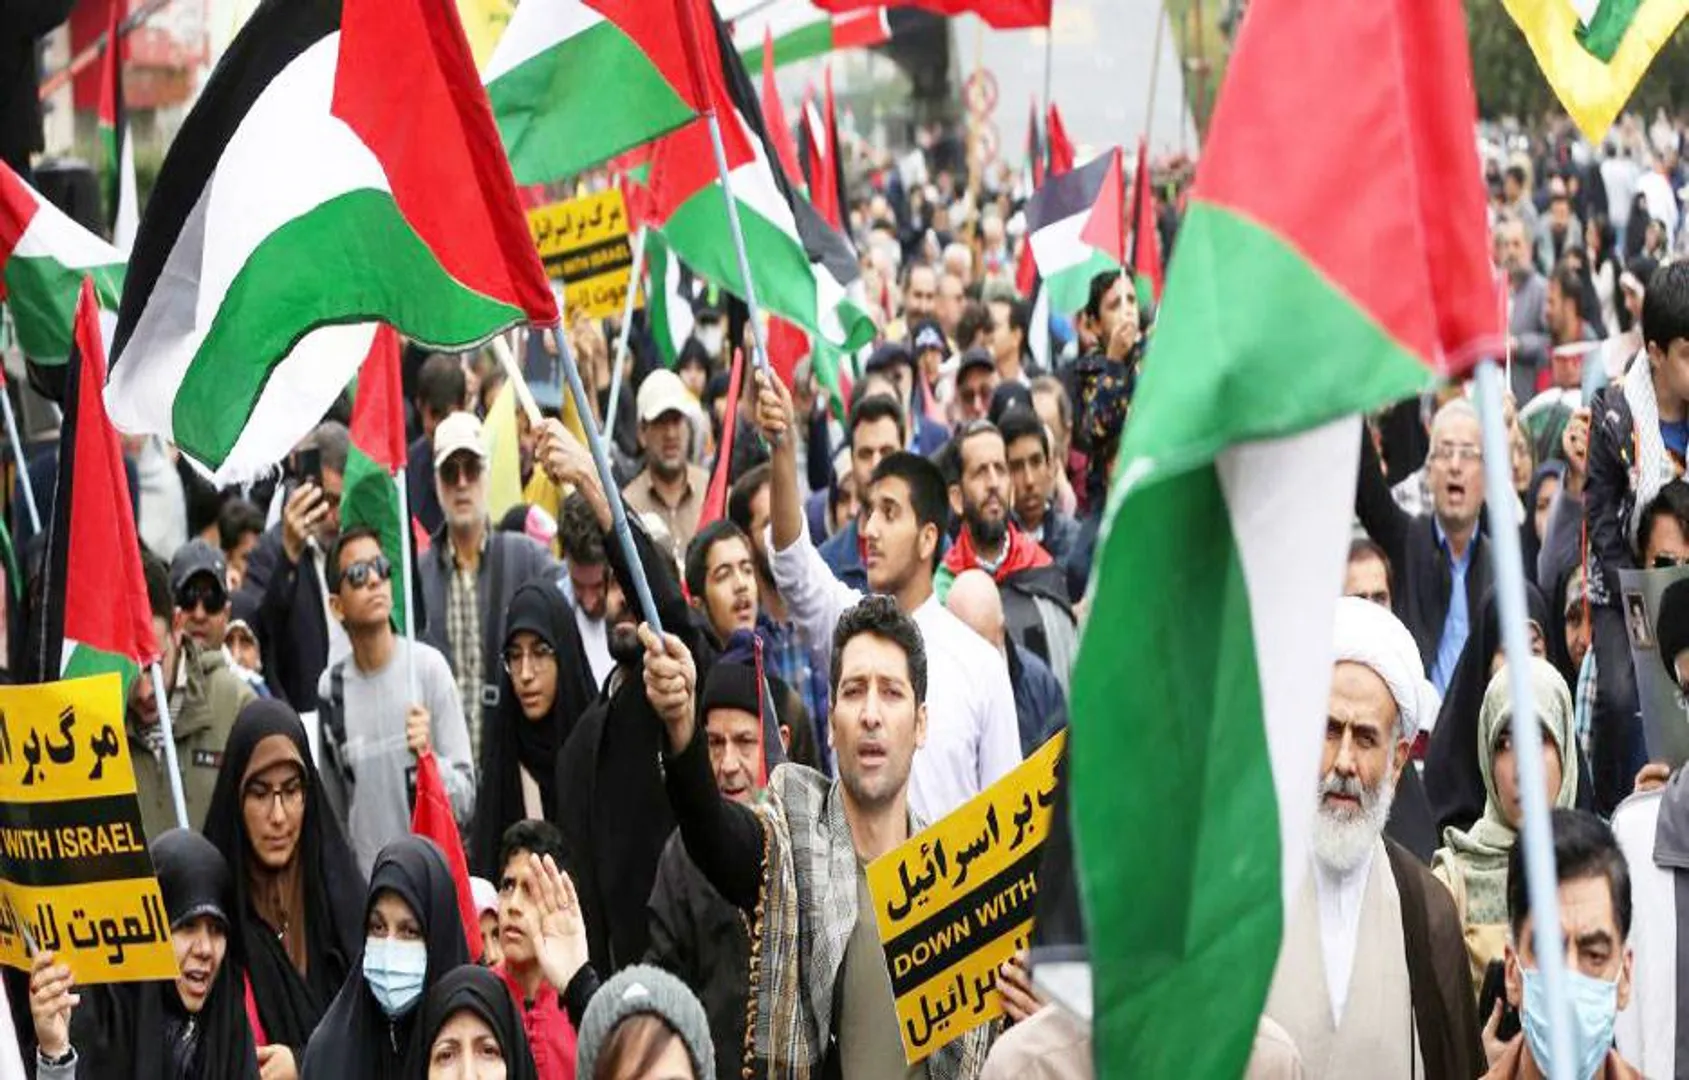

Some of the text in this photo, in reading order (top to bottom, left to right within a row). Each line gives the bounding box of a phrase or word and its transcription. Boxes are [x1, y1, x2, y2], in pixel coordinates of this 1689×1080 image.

[44, 705, 120, 780] مرگ
[0, 822, 144, 860] WITH ISRAEL
[886, 792, 1034, 922] بر اسرائیل
[67, 894, 167, 965] الموت
[894, 872, 1037, 979] DOWN WITH
